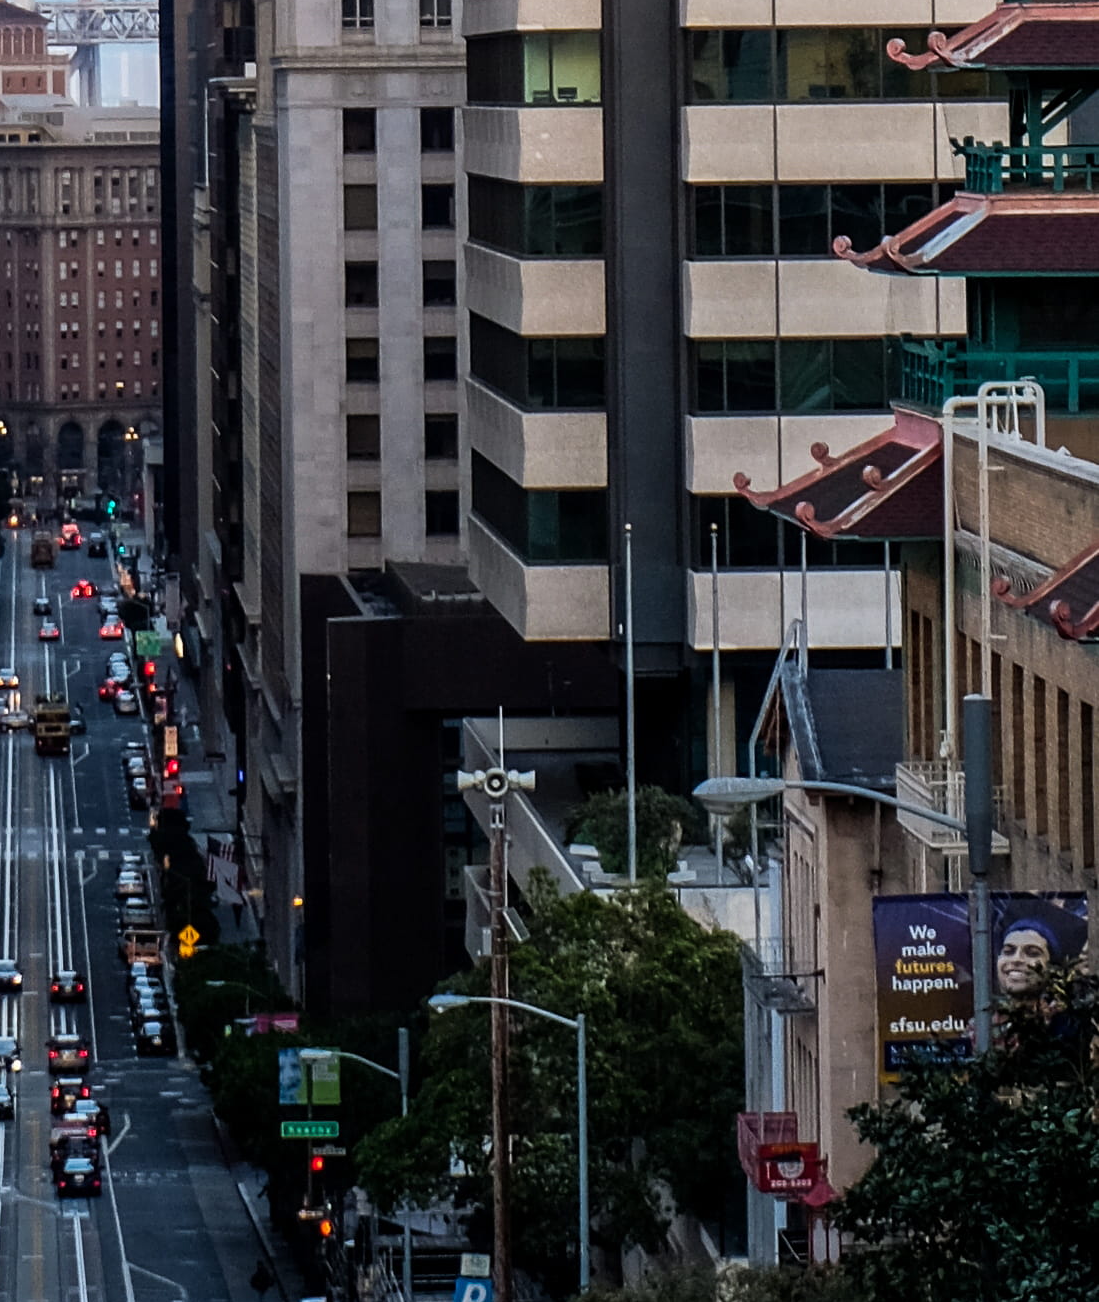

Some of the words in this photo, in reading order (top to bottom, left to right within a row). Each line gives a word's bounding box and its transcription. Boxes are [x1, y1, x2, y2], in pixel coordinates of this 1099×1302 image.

[909, 924, 936, 940] We
[902, 941, 946, 957] make
[895, 958, 954, 974] futures
[891, 975, 959, 993] happen.
[890, 1015, 965, 1033] sfsu.edu
